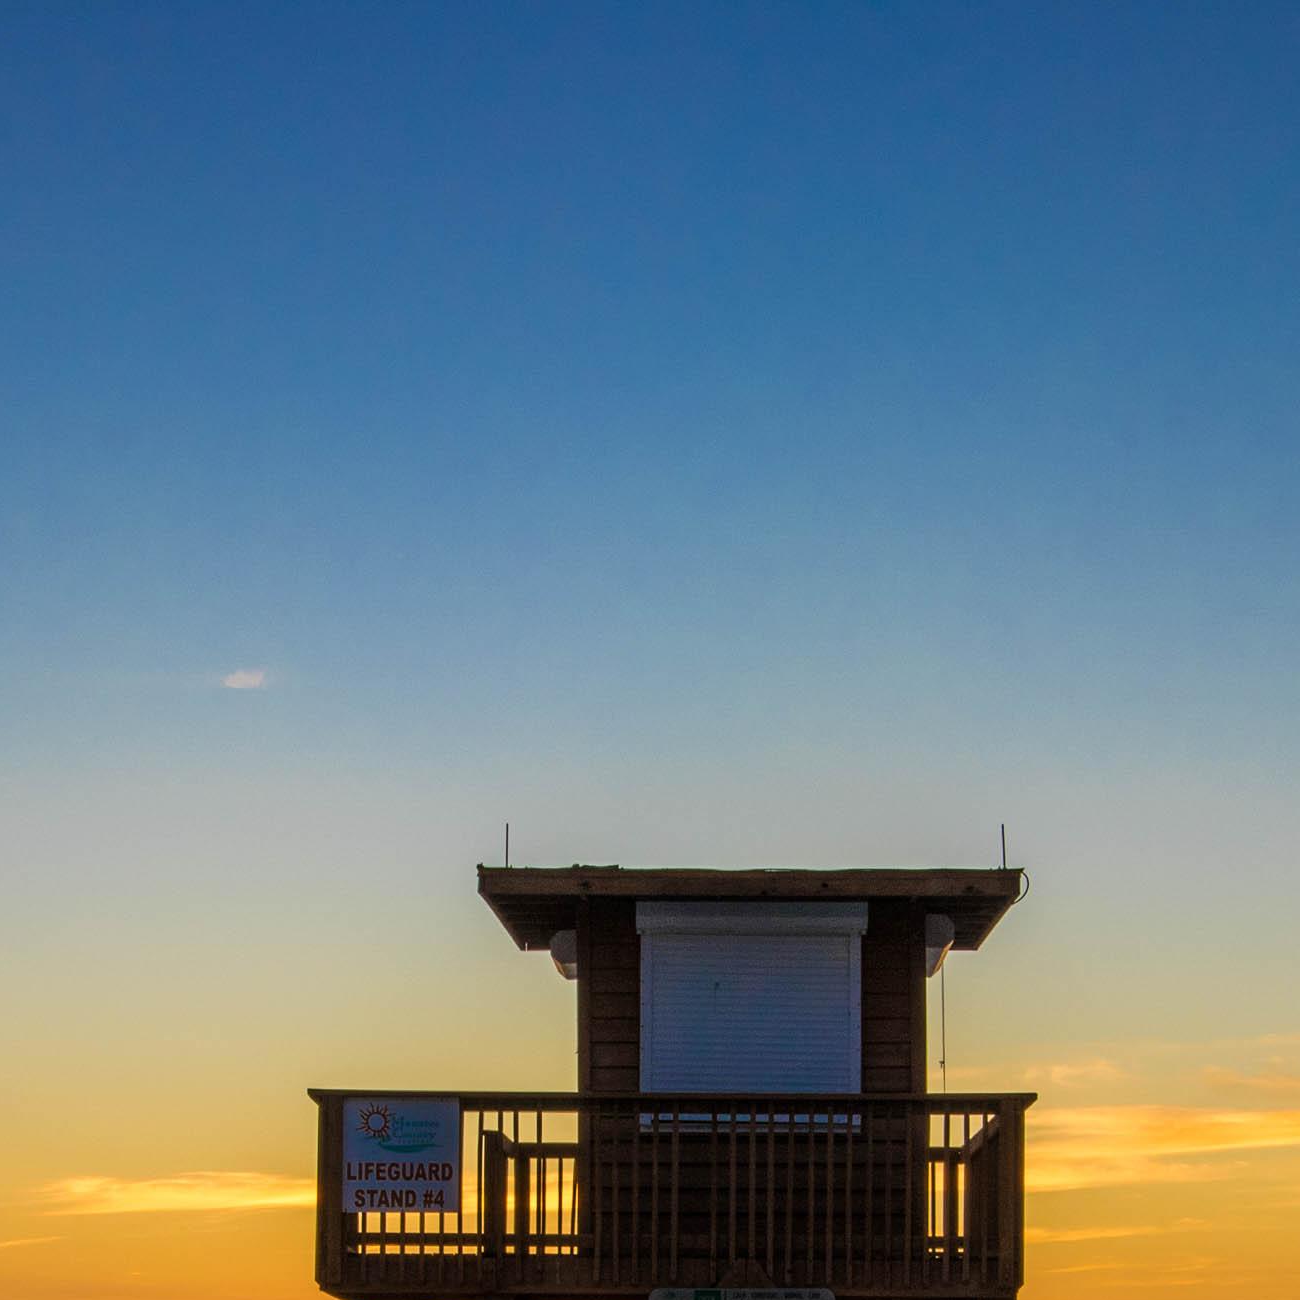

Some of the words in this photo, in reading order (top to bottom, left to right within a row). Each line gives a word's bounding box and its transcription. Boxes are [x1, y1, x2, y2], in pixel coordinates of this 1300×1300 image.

[346, 1162, 453, 1181] LIFEGUARD
[354, 1189, 417, 1208] STAND
[423, 1189, 445, 1208] #4
